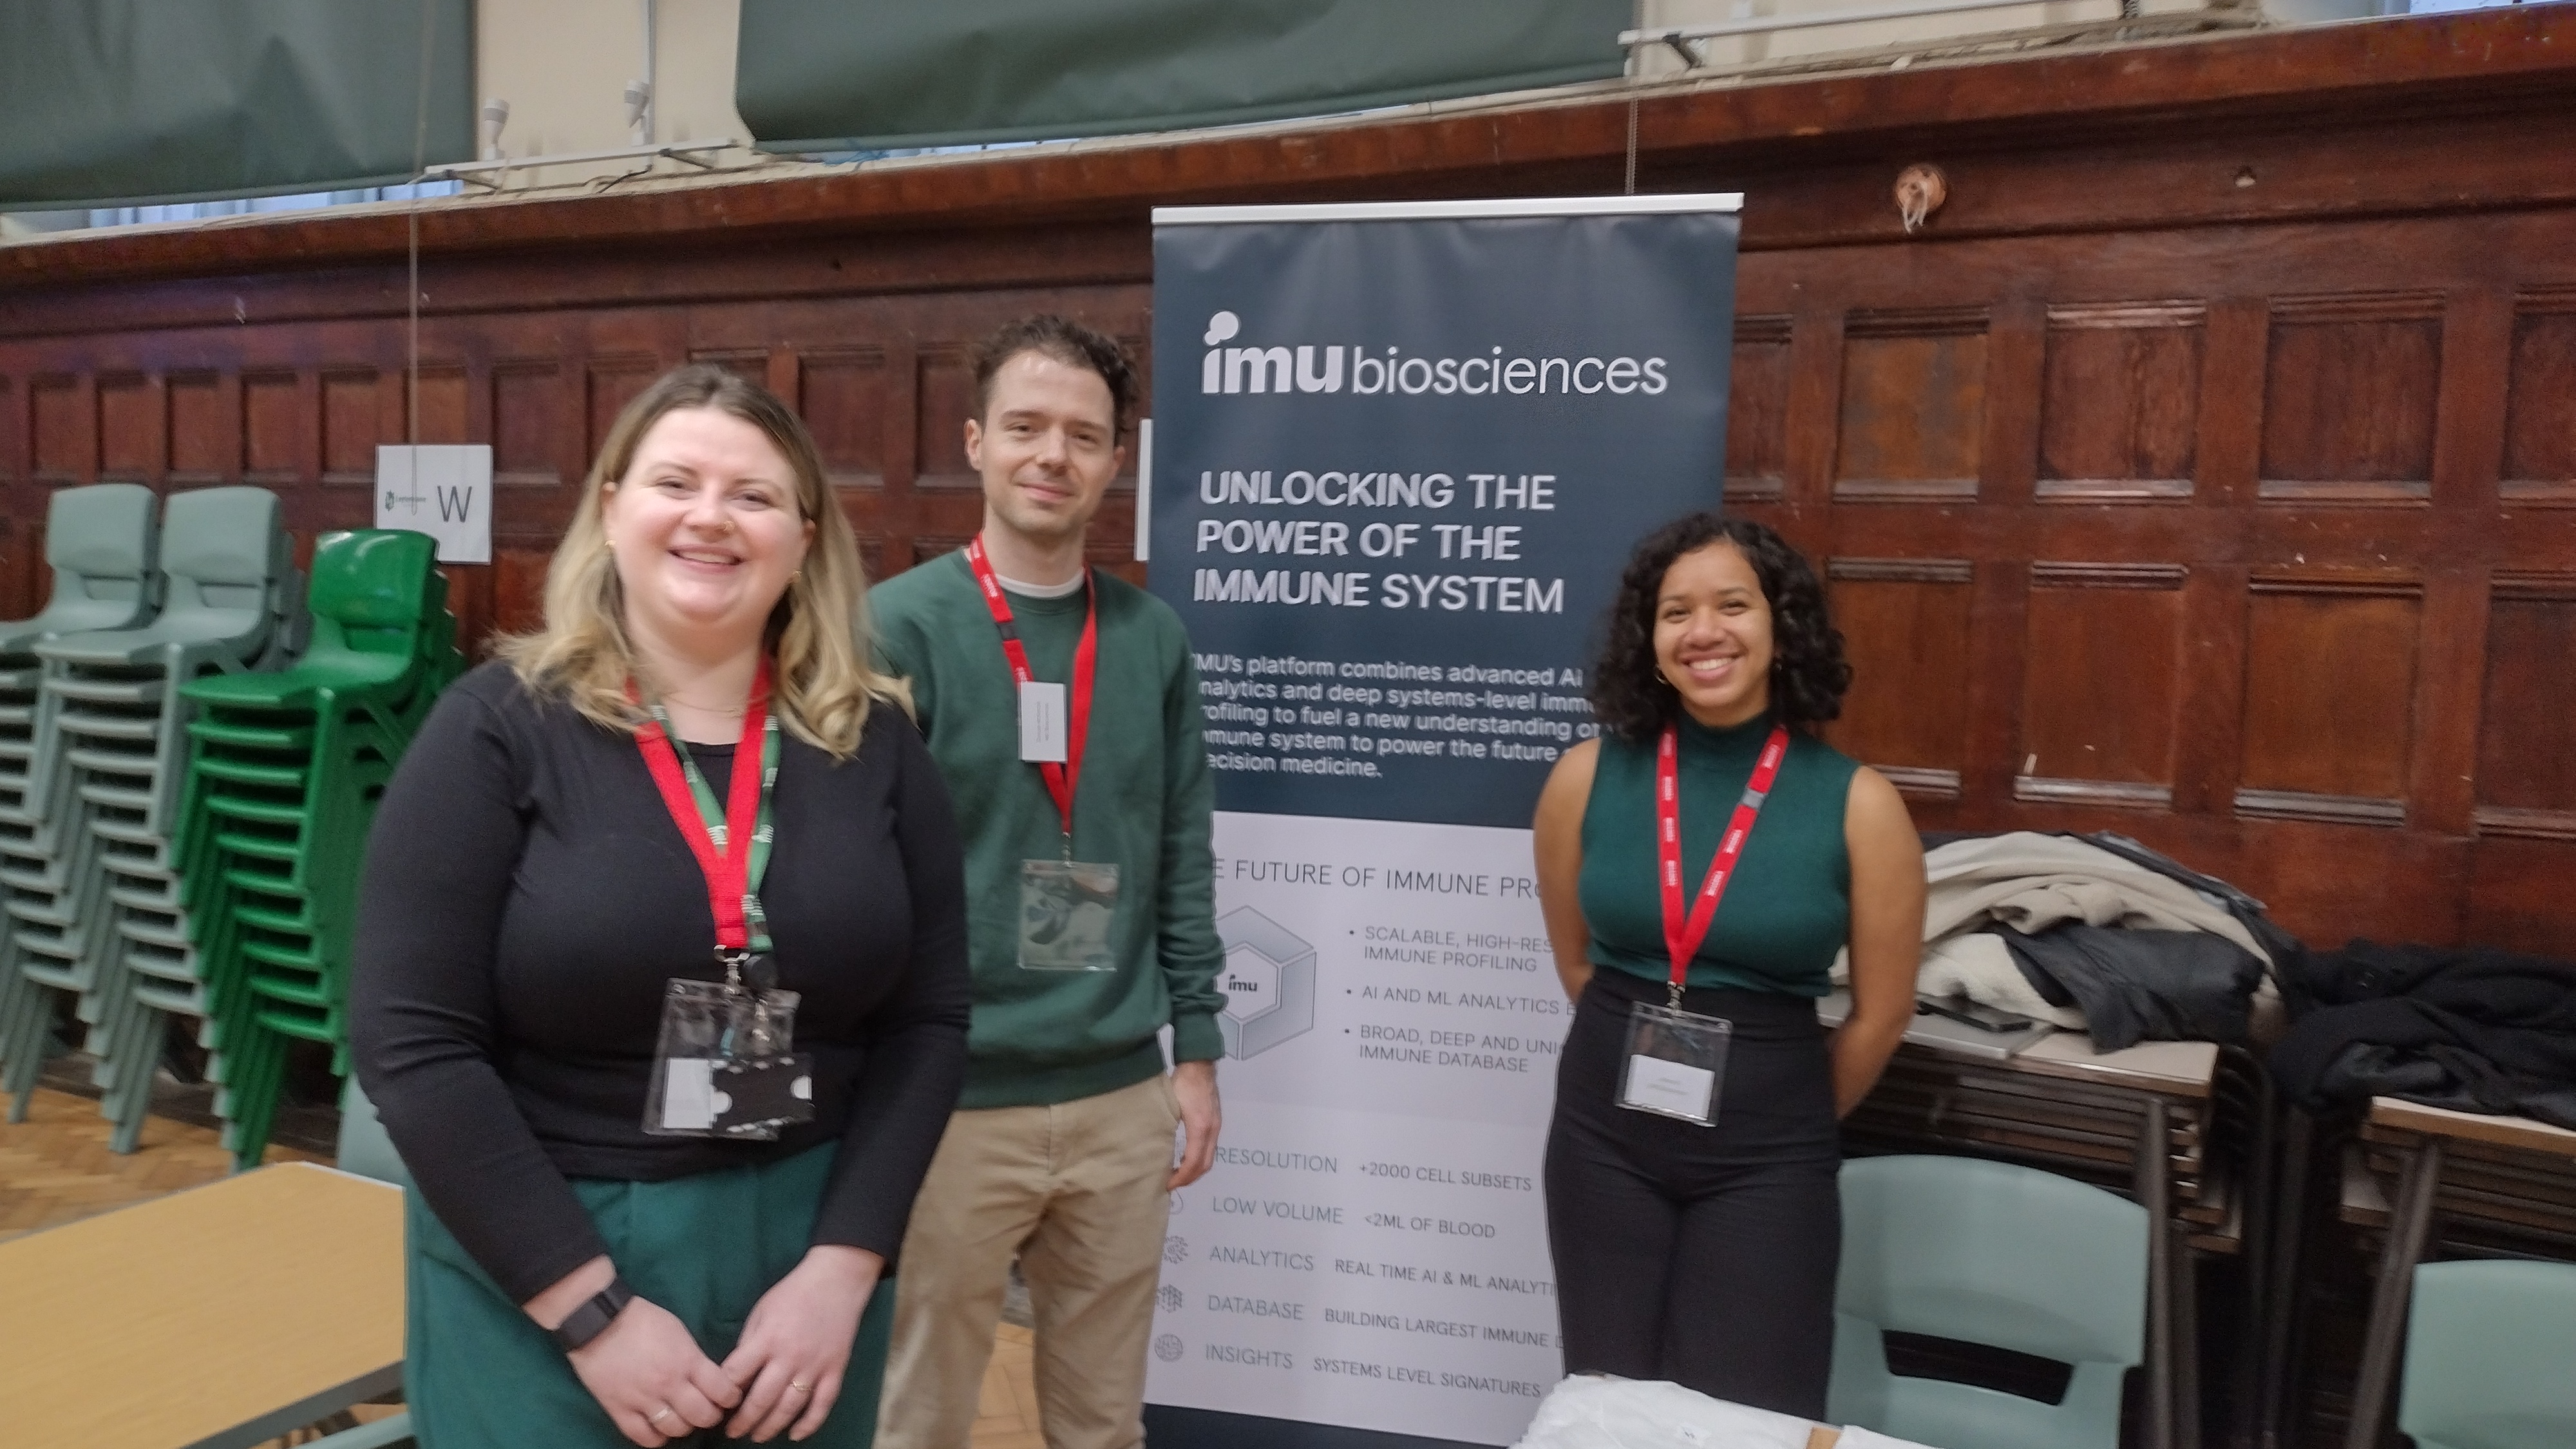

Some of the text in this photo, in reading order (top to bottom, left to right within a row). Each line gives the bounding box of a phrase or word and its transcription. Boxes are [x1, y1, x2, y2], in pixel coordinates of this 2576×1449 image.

[1202, 311, 1668, 394] imu biosciences
[437, 486, 472, 522] W
[1200, 470, 1556, 510] UNLOCKING THE
[1197, 519, 1522, 560] POWER OF THE
[1193, 569, 1564, 614] IMMUNE SYSTEM
[1246, 656, 1335, 678] platform
[1340, 661, 1442, 681] combines
[1447, 665, 1554, 687] advanced
[1198, 678, 1595, 714] nalytics and deep systems-level imm
[1273, 706, 1297, 724] to
[1300, 706, 1341, 726] fuel
[1346, 712, 1360, 728] a
[1365, 712, 1410, 730] new
[1416, 714, 1571, 741] understanding
[1576, 722, 1600, 738] of
[1202, 729, 1558, 762] mune system to power the future
[1206, 751, 1383, 778] ecision medicine.
[1236, 859, 1332, 886] FUTURE
[1343, 866, 1376, 887] OF
[1387, 869, 1489, 896] IMMUNE
[1365, 926, 1554, 953] SCALABLE, HIGH-RES
[1364, 945, 1537, 973] IMMUNE PROFILING
[1228, 974, 1258, 992] imu
[1361, 986, 1377, 999] AI
[1384, 987, 1421, 1003] AND
[1427, 990, 1452, 1006] ML
[1459, 994, 1559, 1016] ANALYTICS
[1361, 1025, 1563, 1056] BROAD, DEEP AND UNI
[1359, 1045, 1529, 1073] IMMUNE DATABASE
[1216, 1146, 1532, 1191] RESOLUTION +2000 CELL SUBSETS
[1213, 1196, 1495, 1238] LOW VOLUME <2ML OF BLOOD
[1209, 1245, 1553, 1296] ANALYTICS REAL TIME AI & ML ANALYTI
[1208, 1295, 1304, 1320] DATABASE
[1325, 1307, 1399, 1331] BUILDING
[1405, 1316, 1478, 1340] LARGEST
[1483, 1326, 1548, 1347] IMMUNE
[1205, 1343, 1541, 1398] INSIGHTS SYSTEMS LEVEL SIGNATURES
